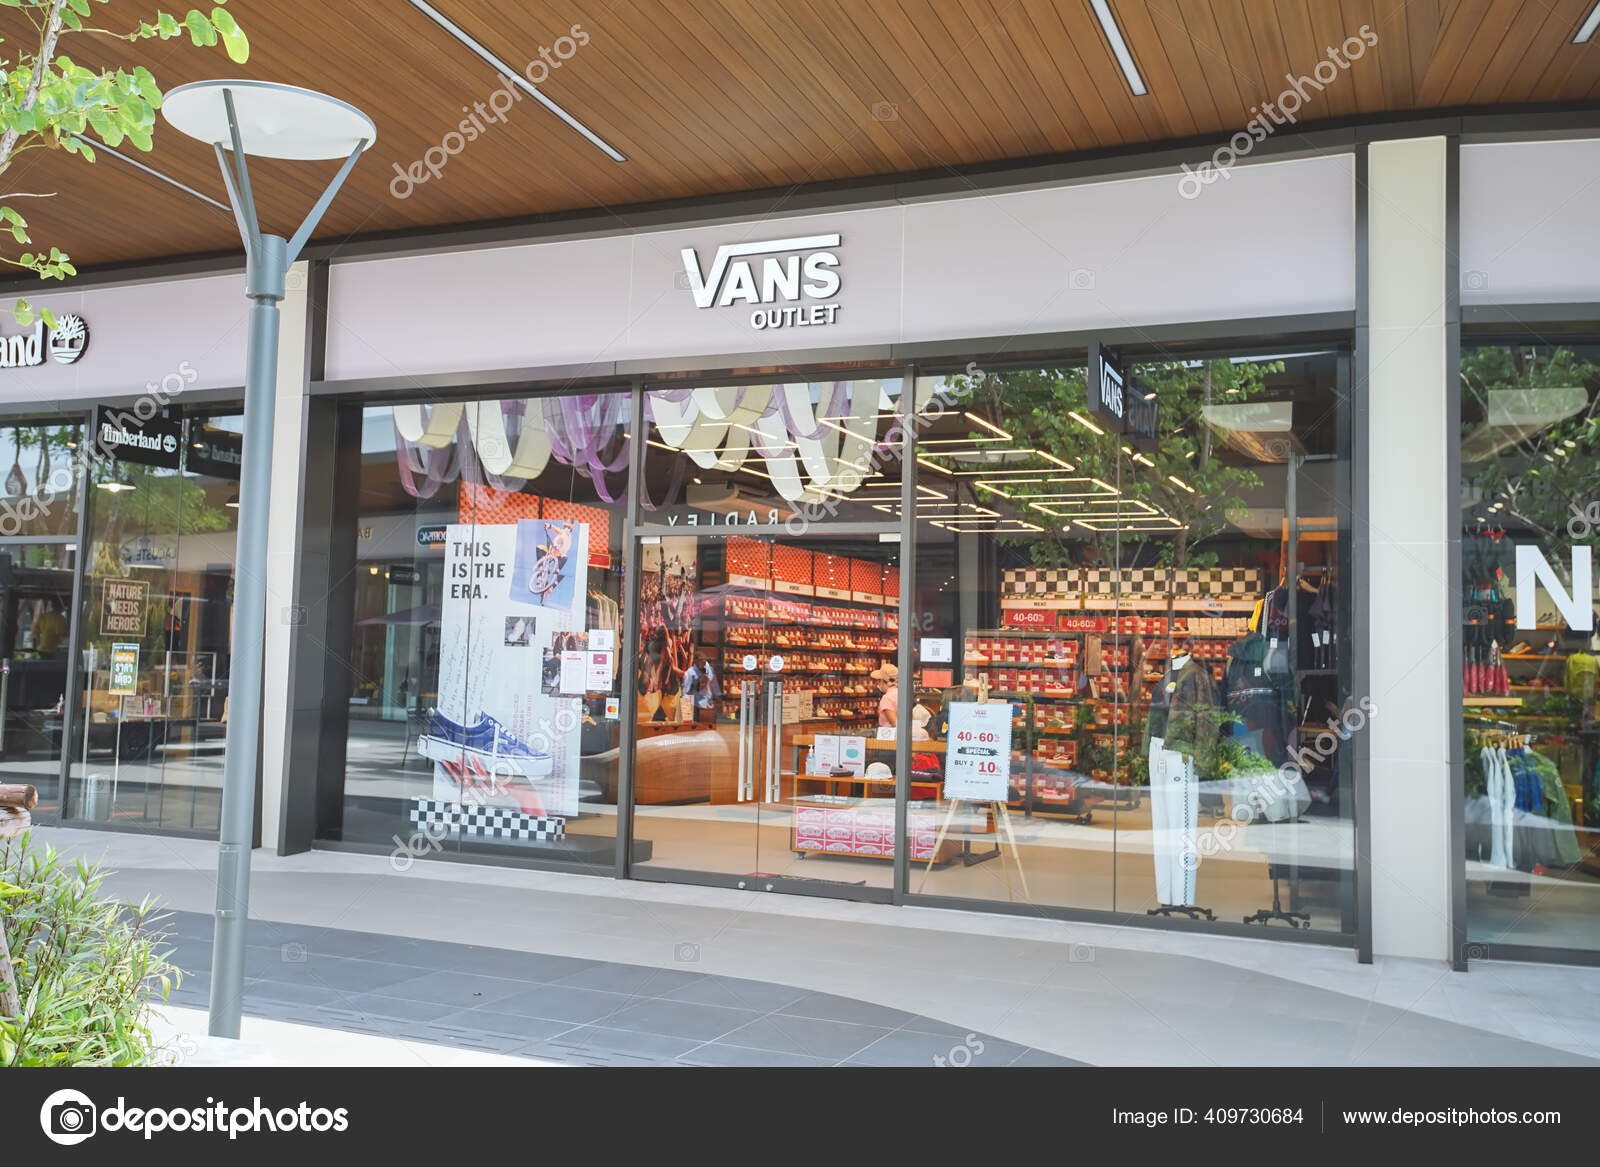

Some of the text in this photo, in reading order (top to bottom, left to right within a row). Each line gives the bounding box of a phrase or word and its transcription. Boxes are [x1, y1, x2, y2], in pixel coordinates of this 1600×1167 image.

[681, 233, 841, 308] VANS
[751, 303, 839, 330] OUTLET
[1099, 354, 1123, 419] VANS
[101, 422, 162, 450] Timberland
[453, 542, 491, 557] THIS
[452, 563, 505, 578] IS THE
[109, 583, 143, 600] NATURE
[451, 584, 488, 599] ERA.
[111, 600, 139, 615] NEEDS
[106, 615, 141, 631] HEROES
[965, 748, 990, 756] SPECIAL
